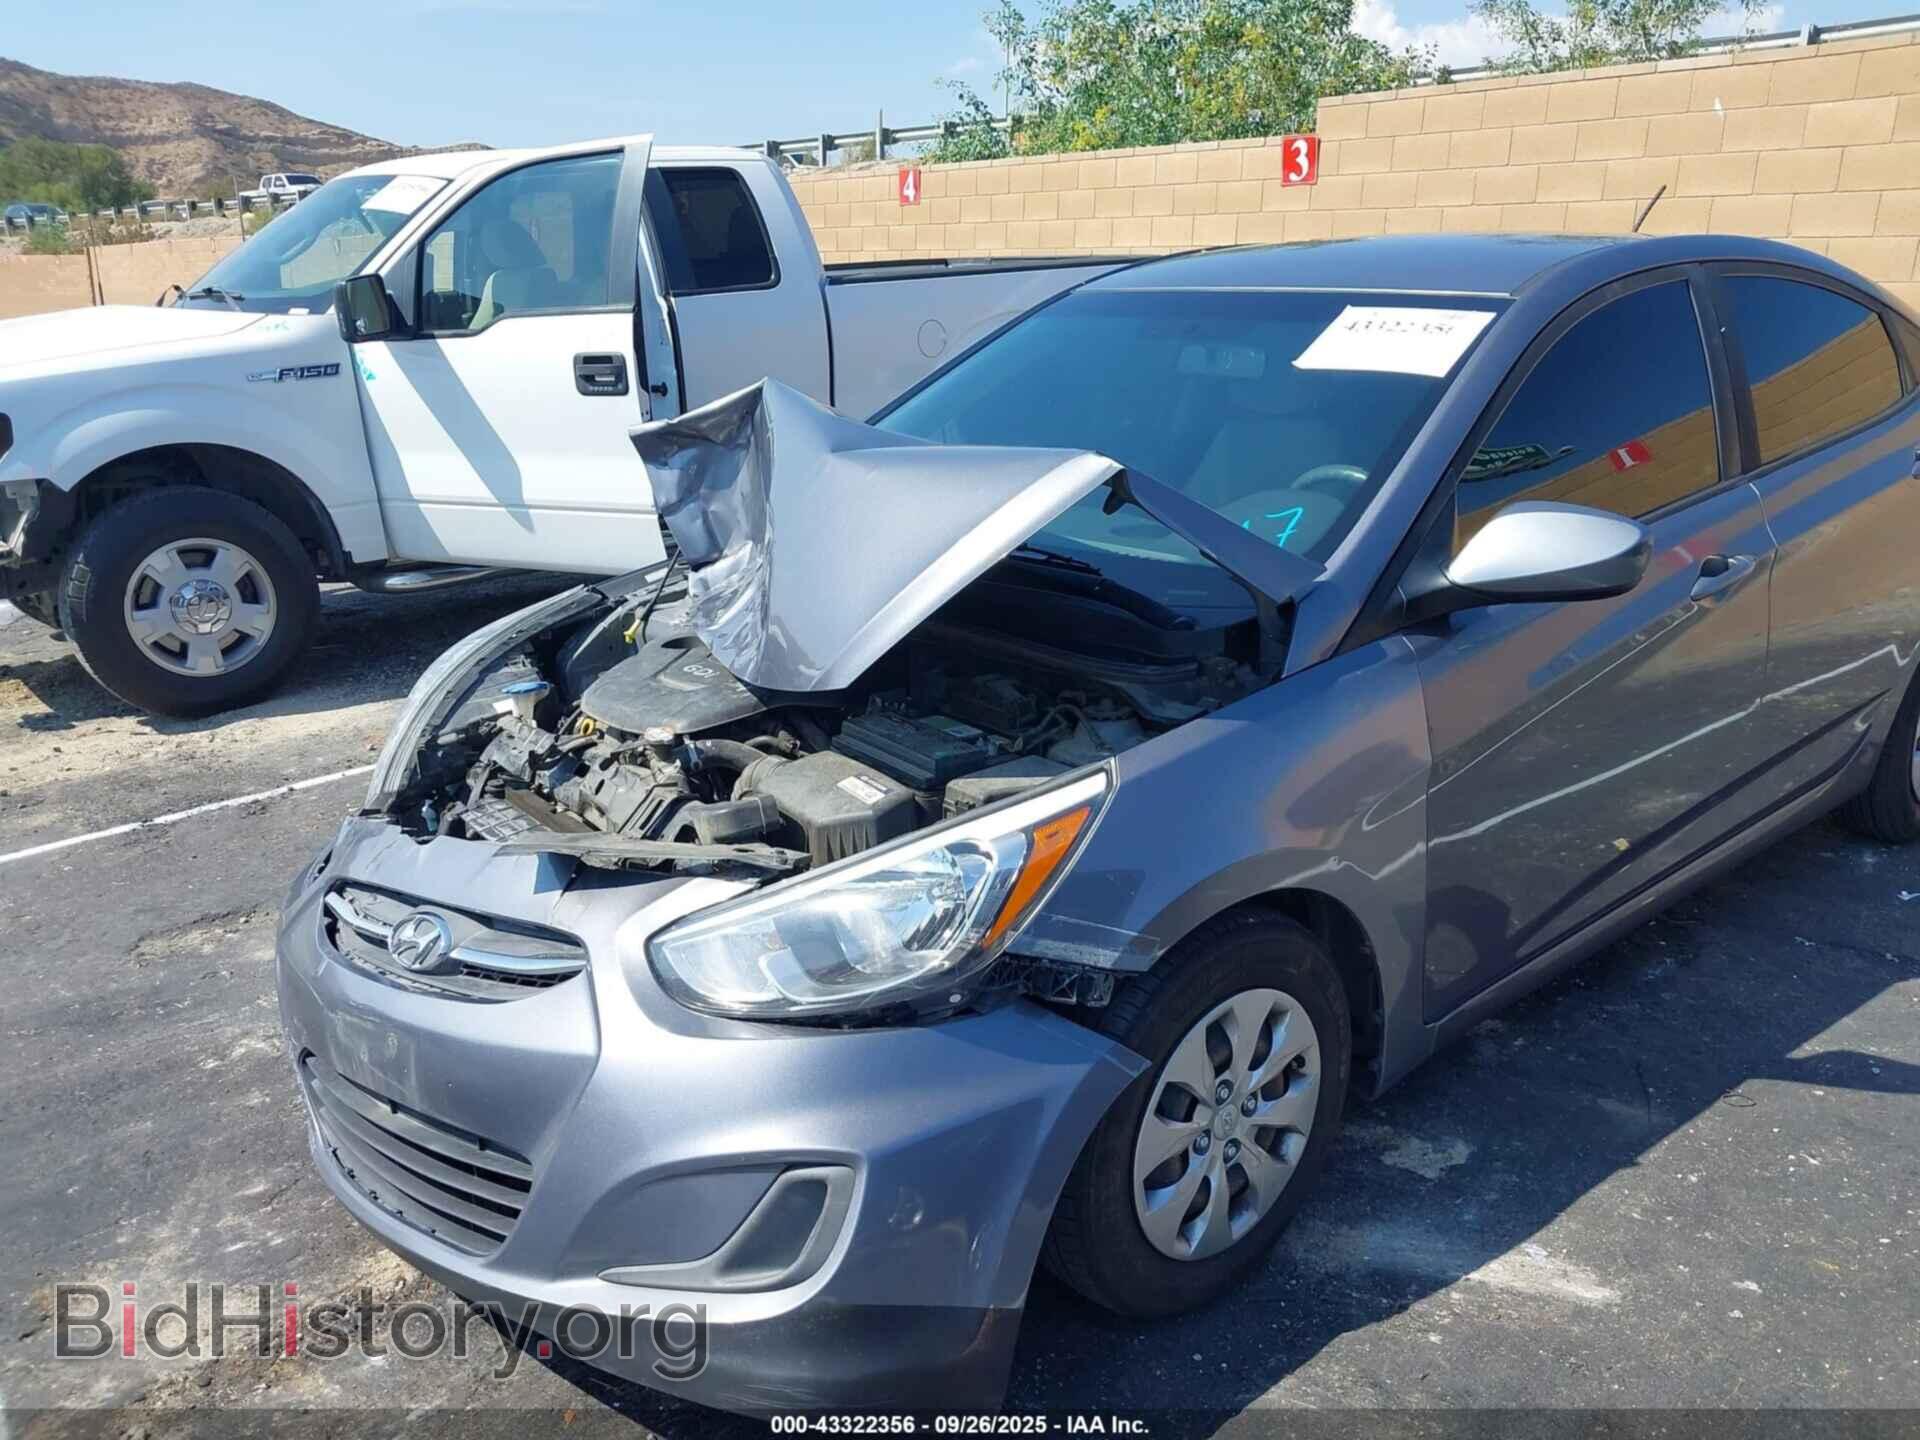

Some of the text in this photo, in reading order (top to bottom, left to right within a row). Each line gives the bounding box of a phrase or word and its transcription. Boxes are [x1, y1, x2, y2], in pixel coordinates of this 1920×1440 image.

[1288, 139, 1310, 182] 3
[902, 171, 916, 203] 4
[1241, 506, 1304, 548] 7
